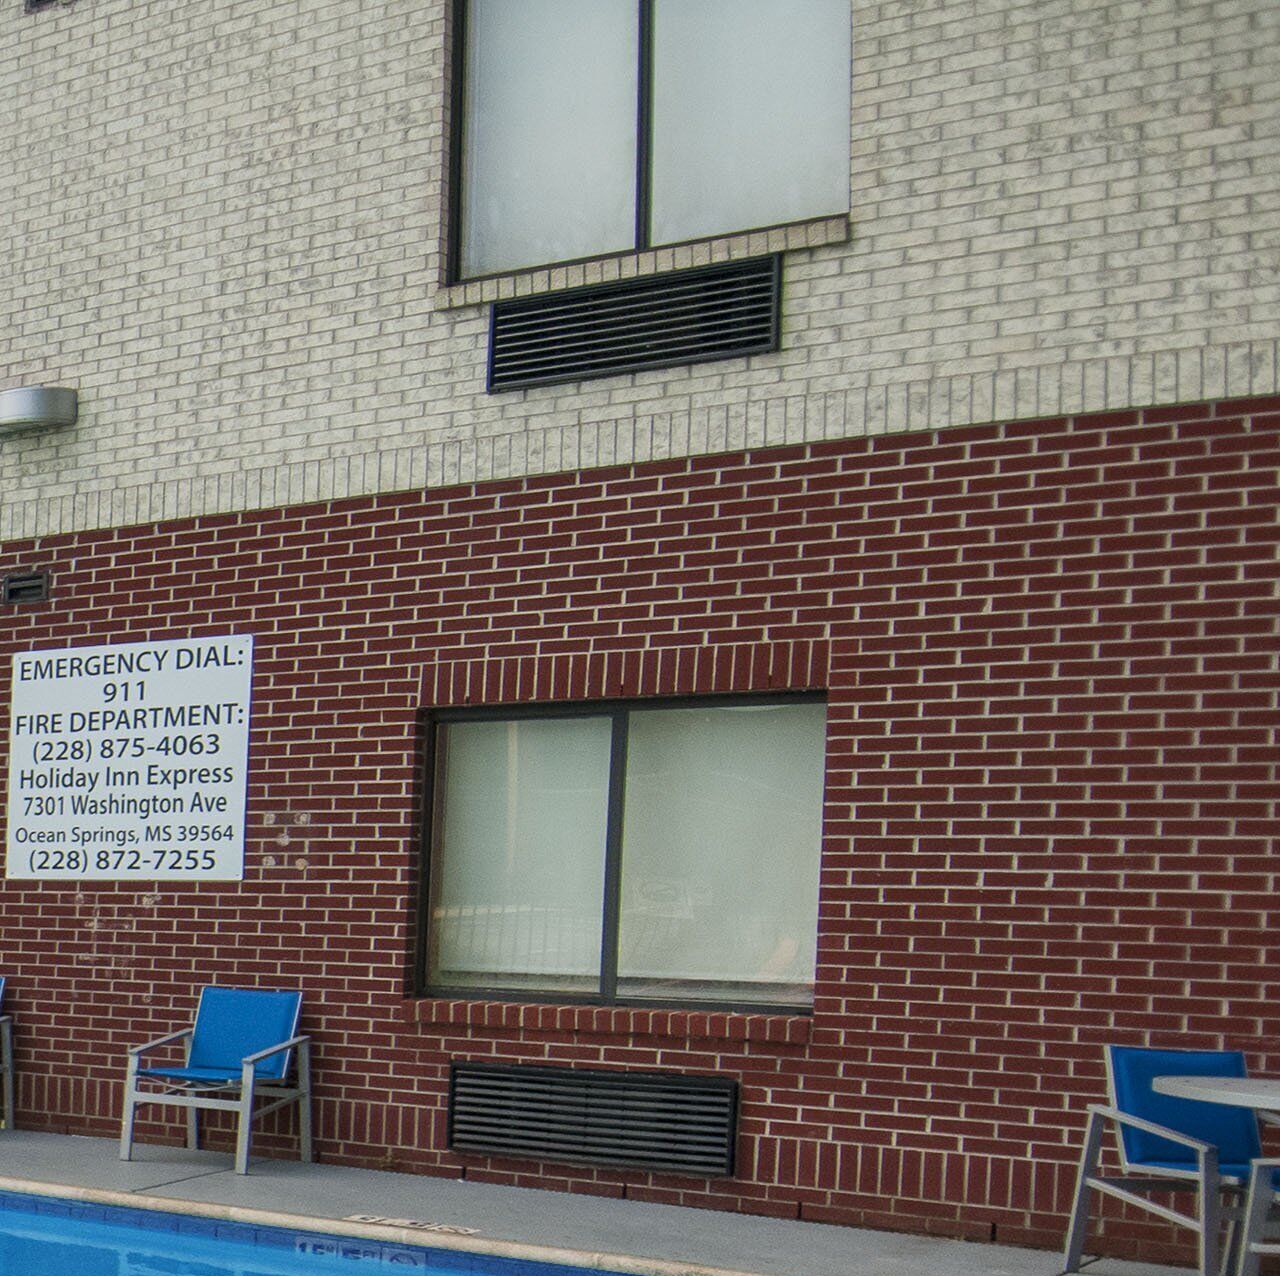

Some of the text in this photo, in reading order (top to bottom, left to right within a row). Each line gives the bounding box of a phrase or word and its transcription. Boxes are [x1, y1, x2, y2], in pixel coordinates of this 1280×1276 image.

[20, 645, 244, 681] EMERGENCY DIAL:
[103, 681, 146, 702] 911
[16, 703, 244, 735] FIRE DEPARTMENT:
[33, 734, 220, 764] (228) 875-4063
[20, 765, 233, 792] Holiday Inn Express
[24, 792, 227, 819] 7301 Washington Ave
[15, 825, 234, 846] Ocean Springs, MS 39564
[29, 850, 216, 872] (228) 872-7255
